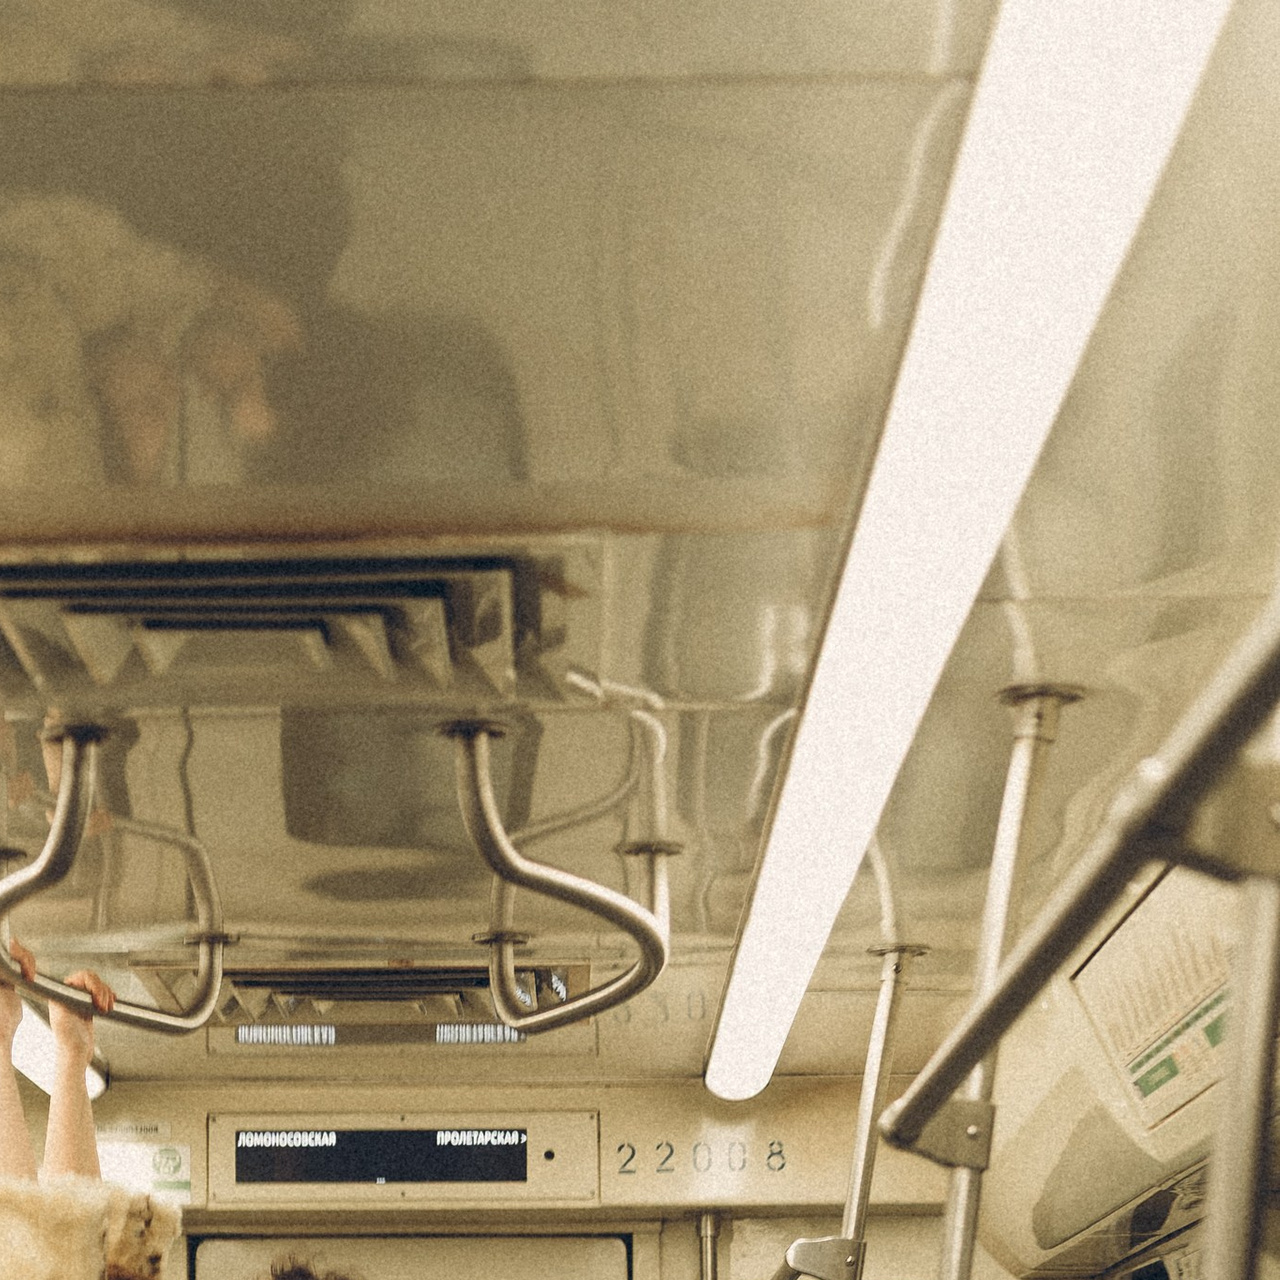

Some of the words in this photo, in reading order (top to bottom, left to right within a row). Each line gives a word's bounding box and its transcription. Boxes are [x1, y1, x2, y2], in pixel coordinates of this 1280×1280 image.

[237, 1131, 337, 1148] ЛОМОНОСОВСКАЯ
[436, 1130, 520, 1146] ПРОЛЕТАРСКАЯ
[616, 1140, 787, 1174] 22008
